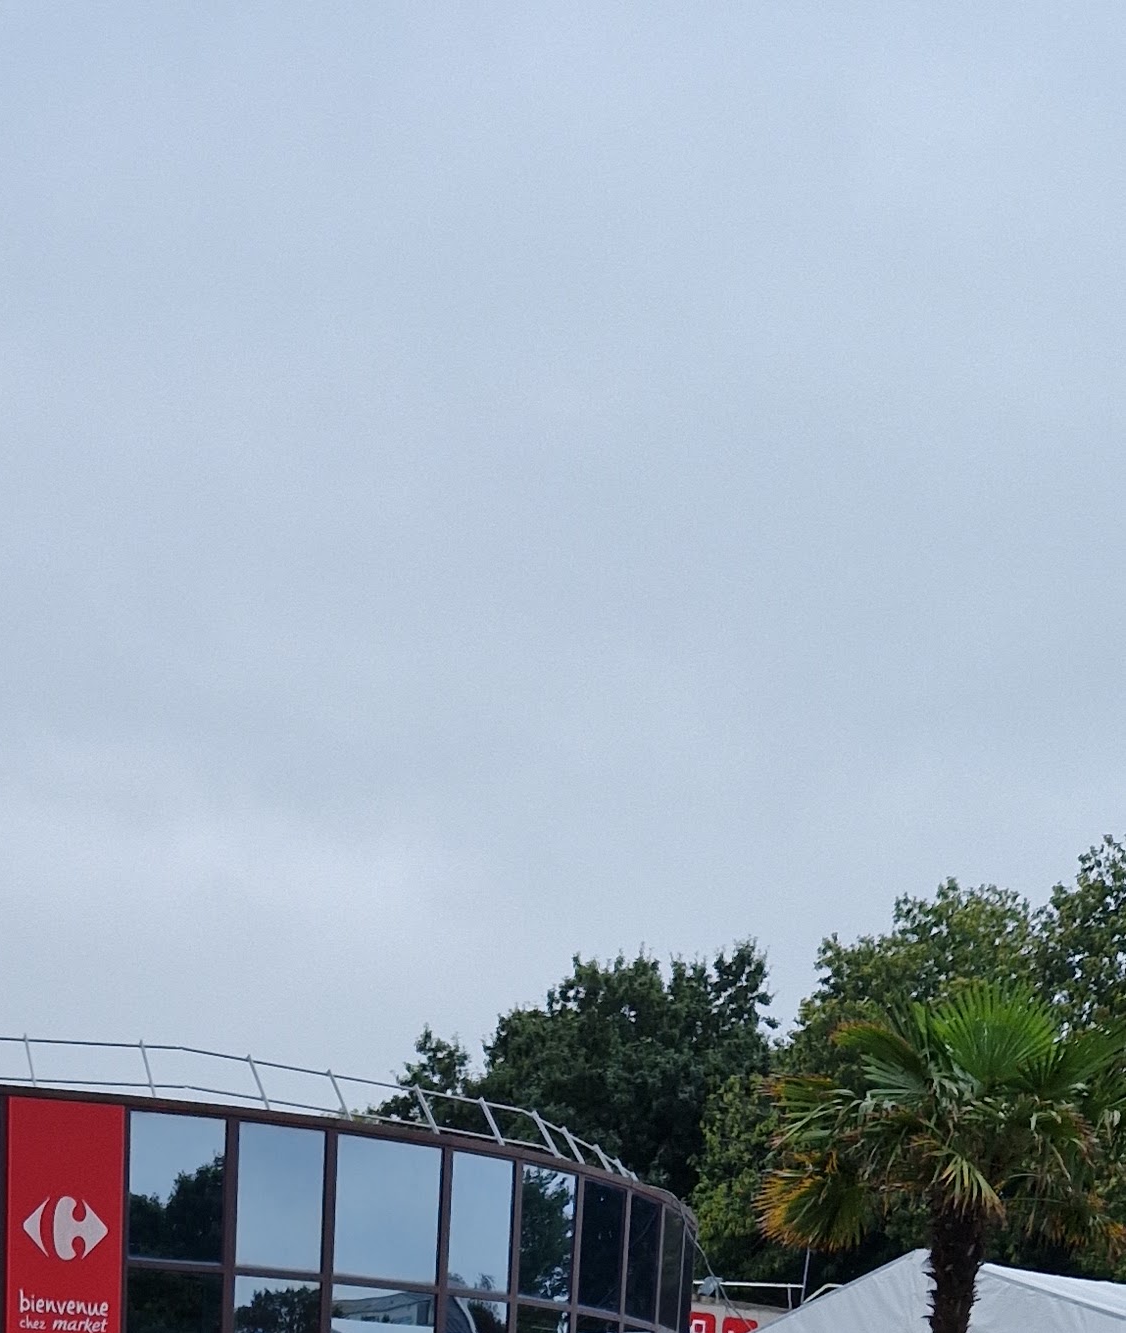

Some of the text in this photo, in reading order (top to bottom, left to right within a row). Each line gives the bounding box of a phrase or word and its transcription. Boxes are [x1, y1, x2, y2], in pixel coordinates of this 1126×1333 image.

[18, 1288, 109, 1317] bienvenue
[18, 1314, 109, 1333] chez market
